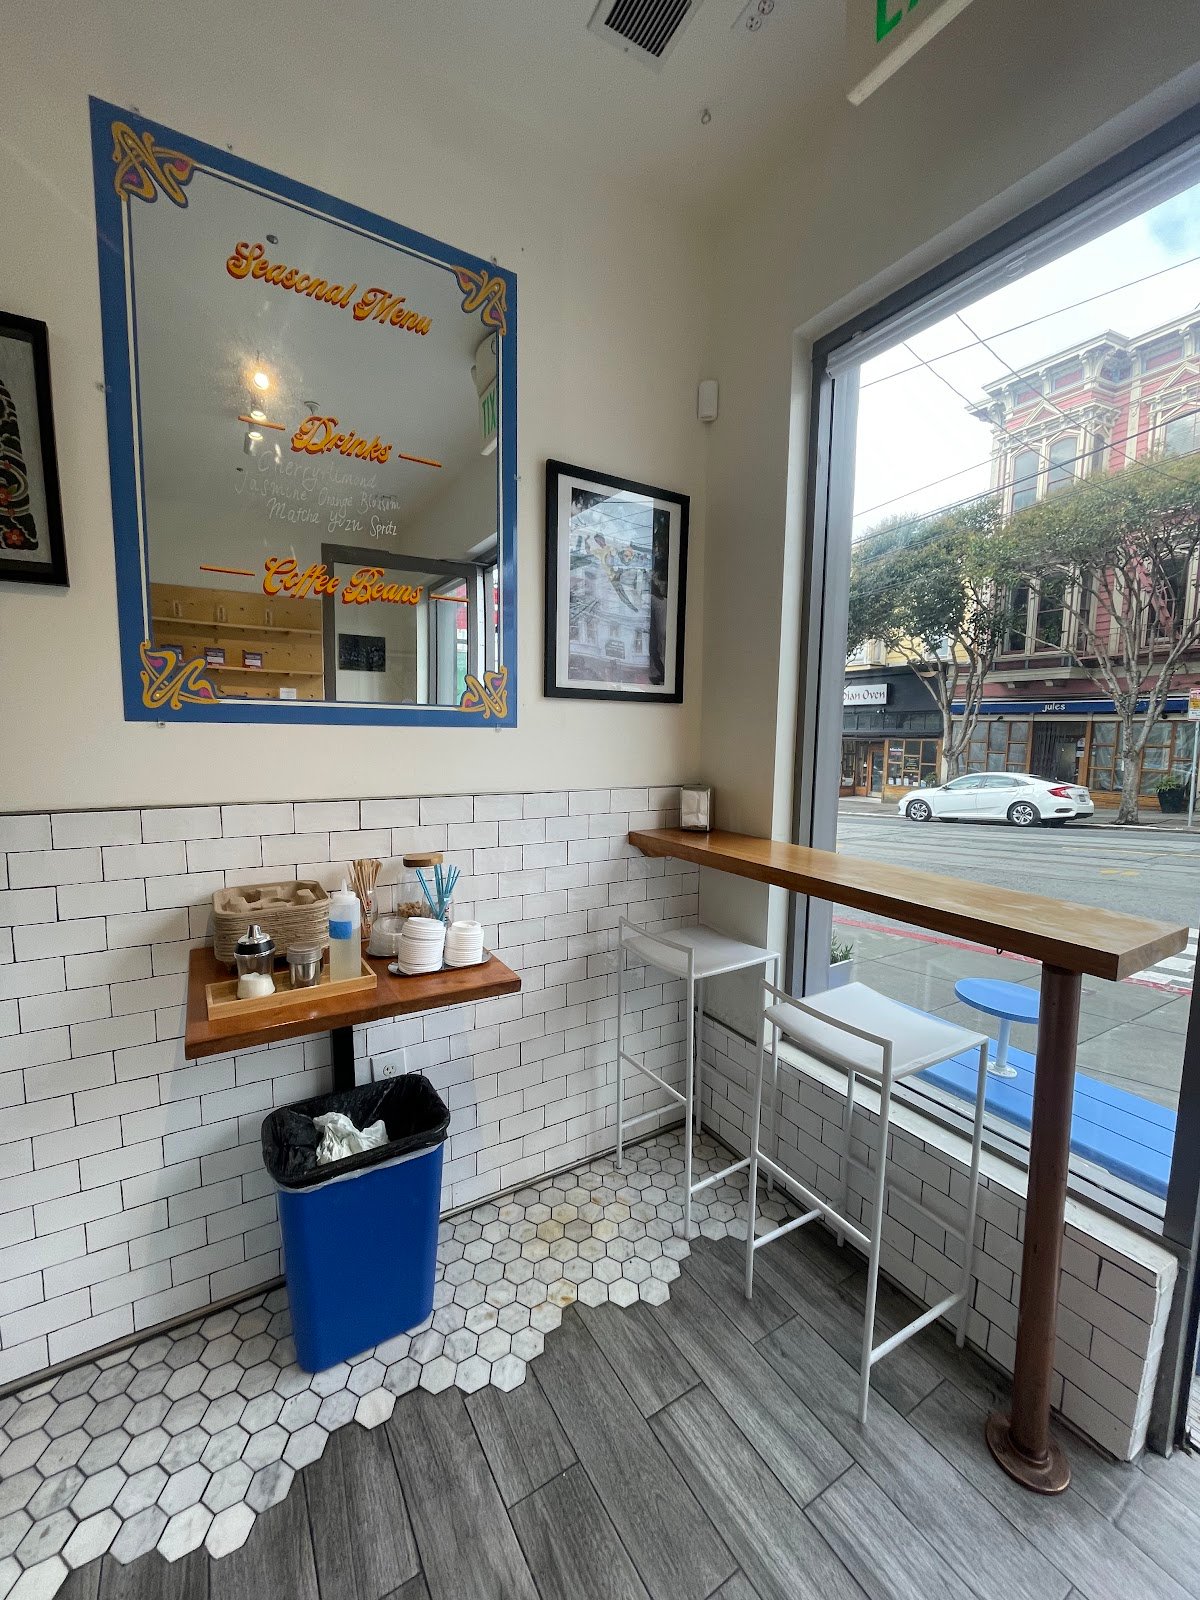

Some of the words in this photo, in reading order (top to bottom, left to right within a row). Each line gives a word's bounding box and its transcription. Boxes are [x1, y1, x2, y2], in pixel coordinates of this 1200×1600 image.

[226, 241, 358, 309] Seasonal
[353, 287, 434, 335] Menu
[290, 414, 393, 465] Drinks
[257, 450, 320, 492] Cherry
[234, 470, 308, 501] Jasmine
[318, 486, 353, 519] Orange
[357, 491, 402, 515] Blossom
[267, 497, 321, 524] Matcha
[369, 514, 398, 540] Spritz
[262, 555, 343, 600] Coffee
[341, 566, 424, 606] Beans
[862, 689, 886, 700] Oven
[1042, 702, 1066, 713] jules
